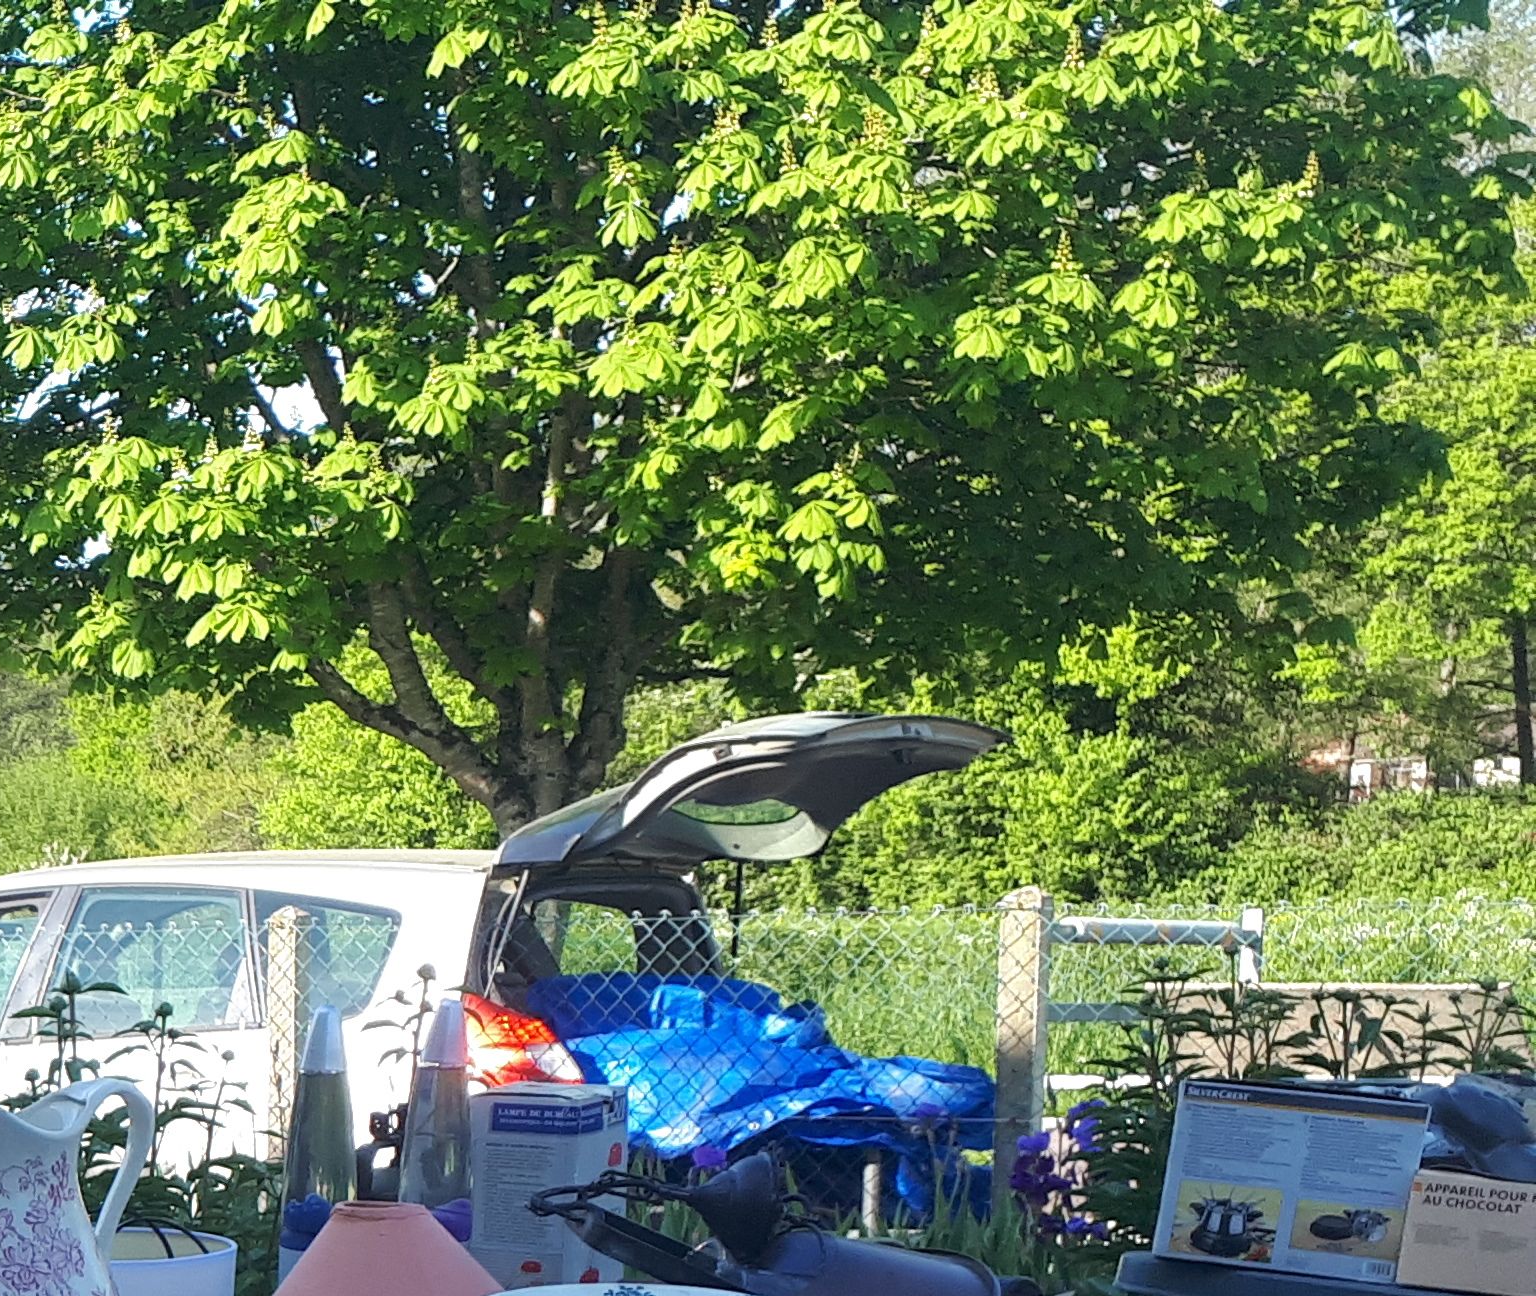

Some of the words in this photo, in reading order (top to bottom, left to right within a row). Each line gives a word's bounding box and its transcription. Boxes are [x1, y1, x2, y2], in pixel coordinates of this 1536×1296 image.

[1424, 1182, 1486, 1199] APPAREIL
[1489, 1188, 1528, 1203] POUR
[1422, 1194, 1442, 1206] AU
[1446, 1196, 1522, 1214] CHOCOLAT
